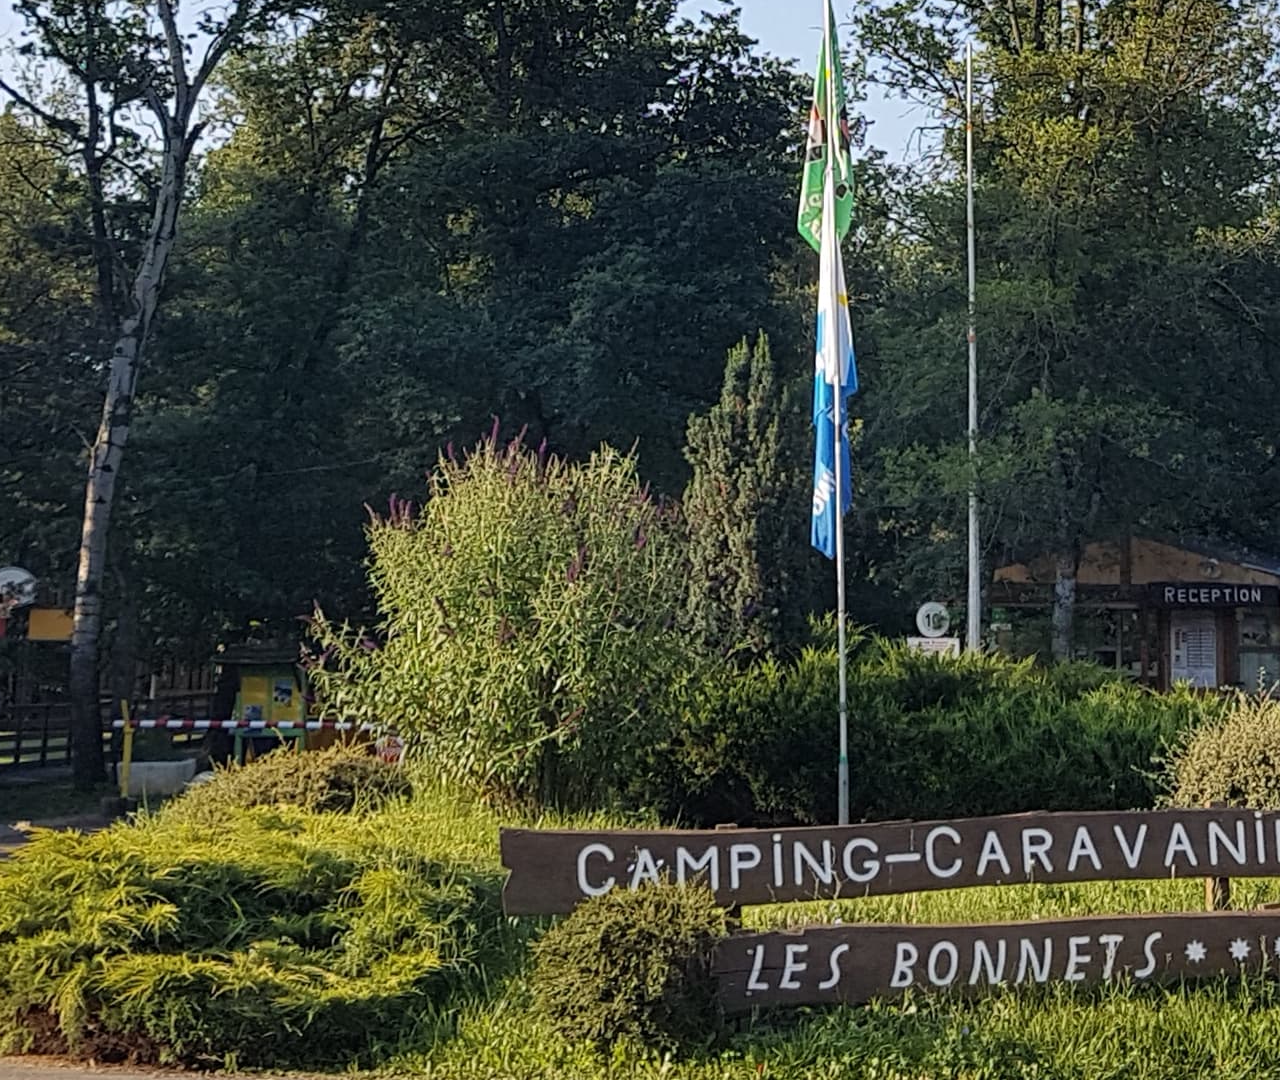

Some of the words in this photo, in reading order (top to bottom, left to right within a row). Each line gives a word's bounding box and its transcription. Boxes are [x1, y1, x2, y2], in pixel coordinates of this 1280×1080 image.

[1164, 586, 1261, 603] RECEPTION
[746, 942, 850, 992] LES
[889, 930, 1163, 988] BONNETS
